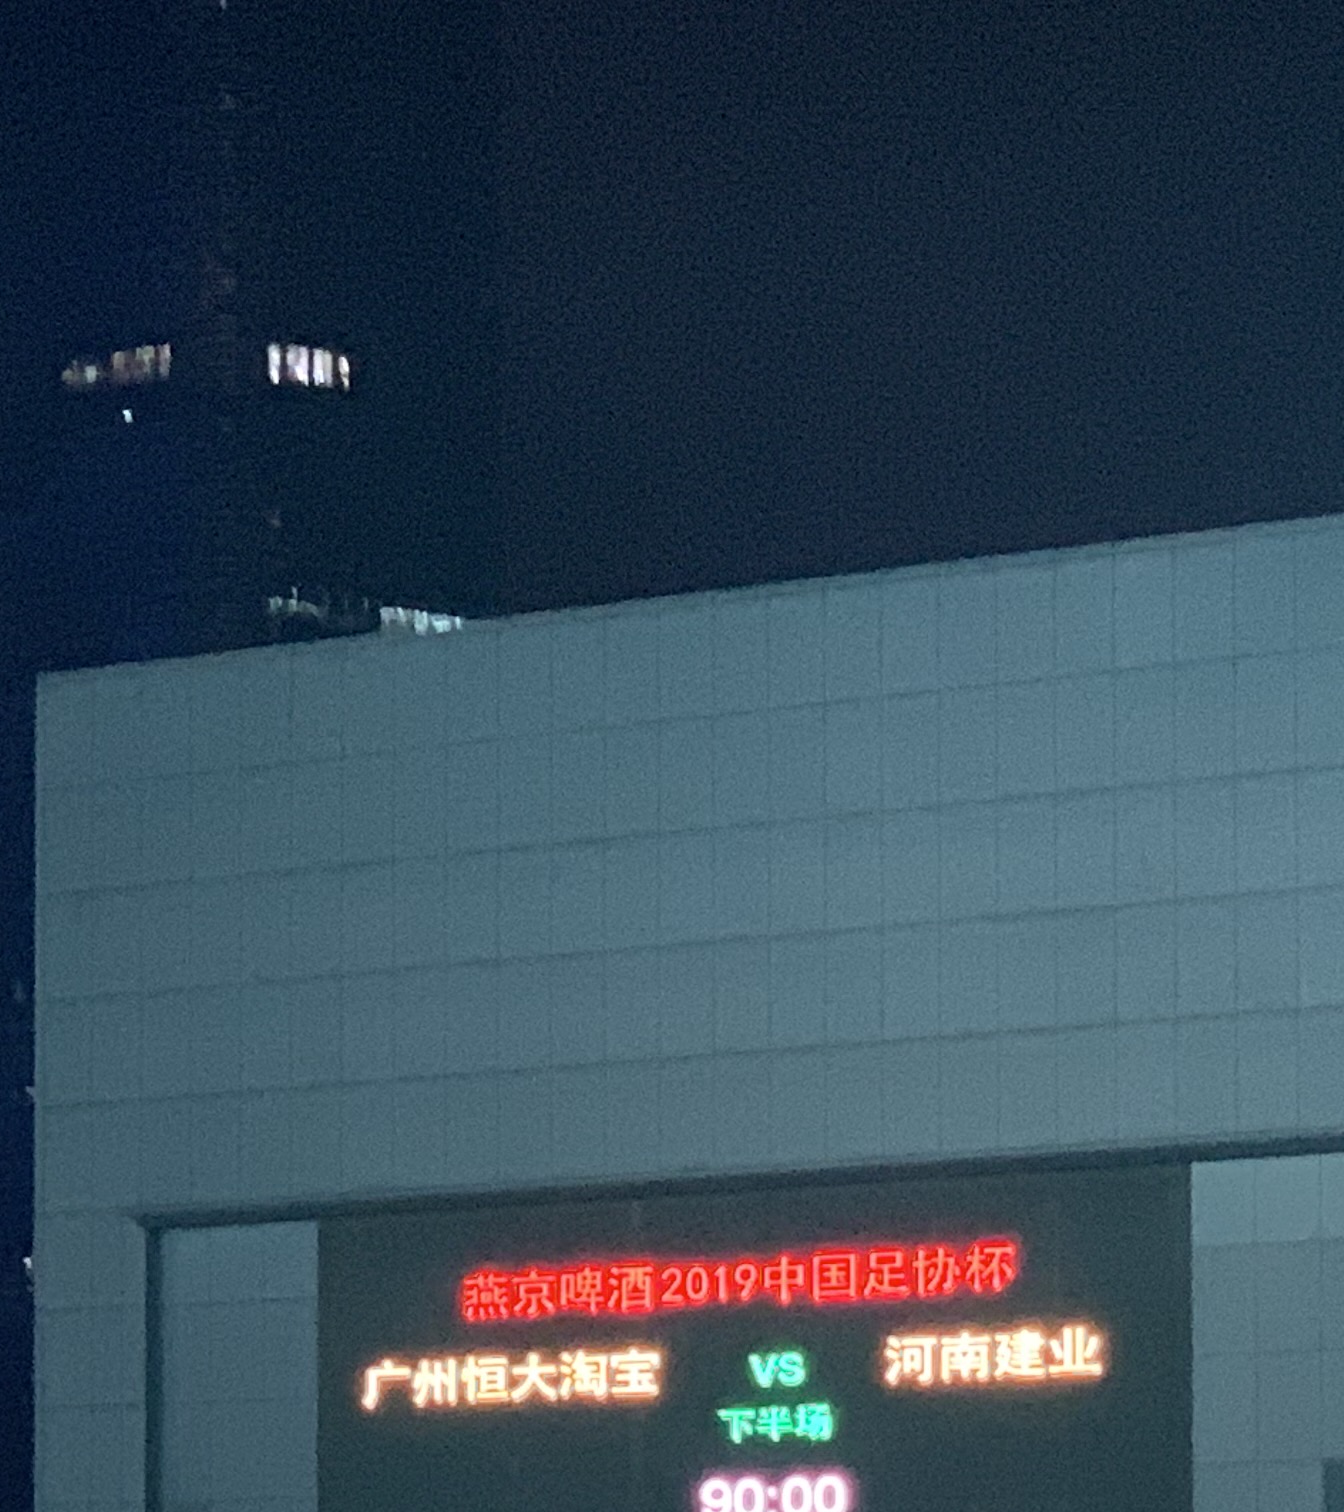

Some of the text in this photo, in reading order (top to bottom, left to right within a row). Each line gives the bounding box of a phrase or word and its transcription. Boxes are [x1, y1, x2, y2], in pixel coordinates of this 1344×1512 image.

[461, 1239, 1018, 1322] 燕京啤酒2019中国足协杯
[361, 1349, 660, 1410] 广州恒大淘宝
[748, 1352, 806, 1388] VS
[883, 1325, 1104, 1386] 河南建业
[717, 1403, 835, 1444] 下半场
